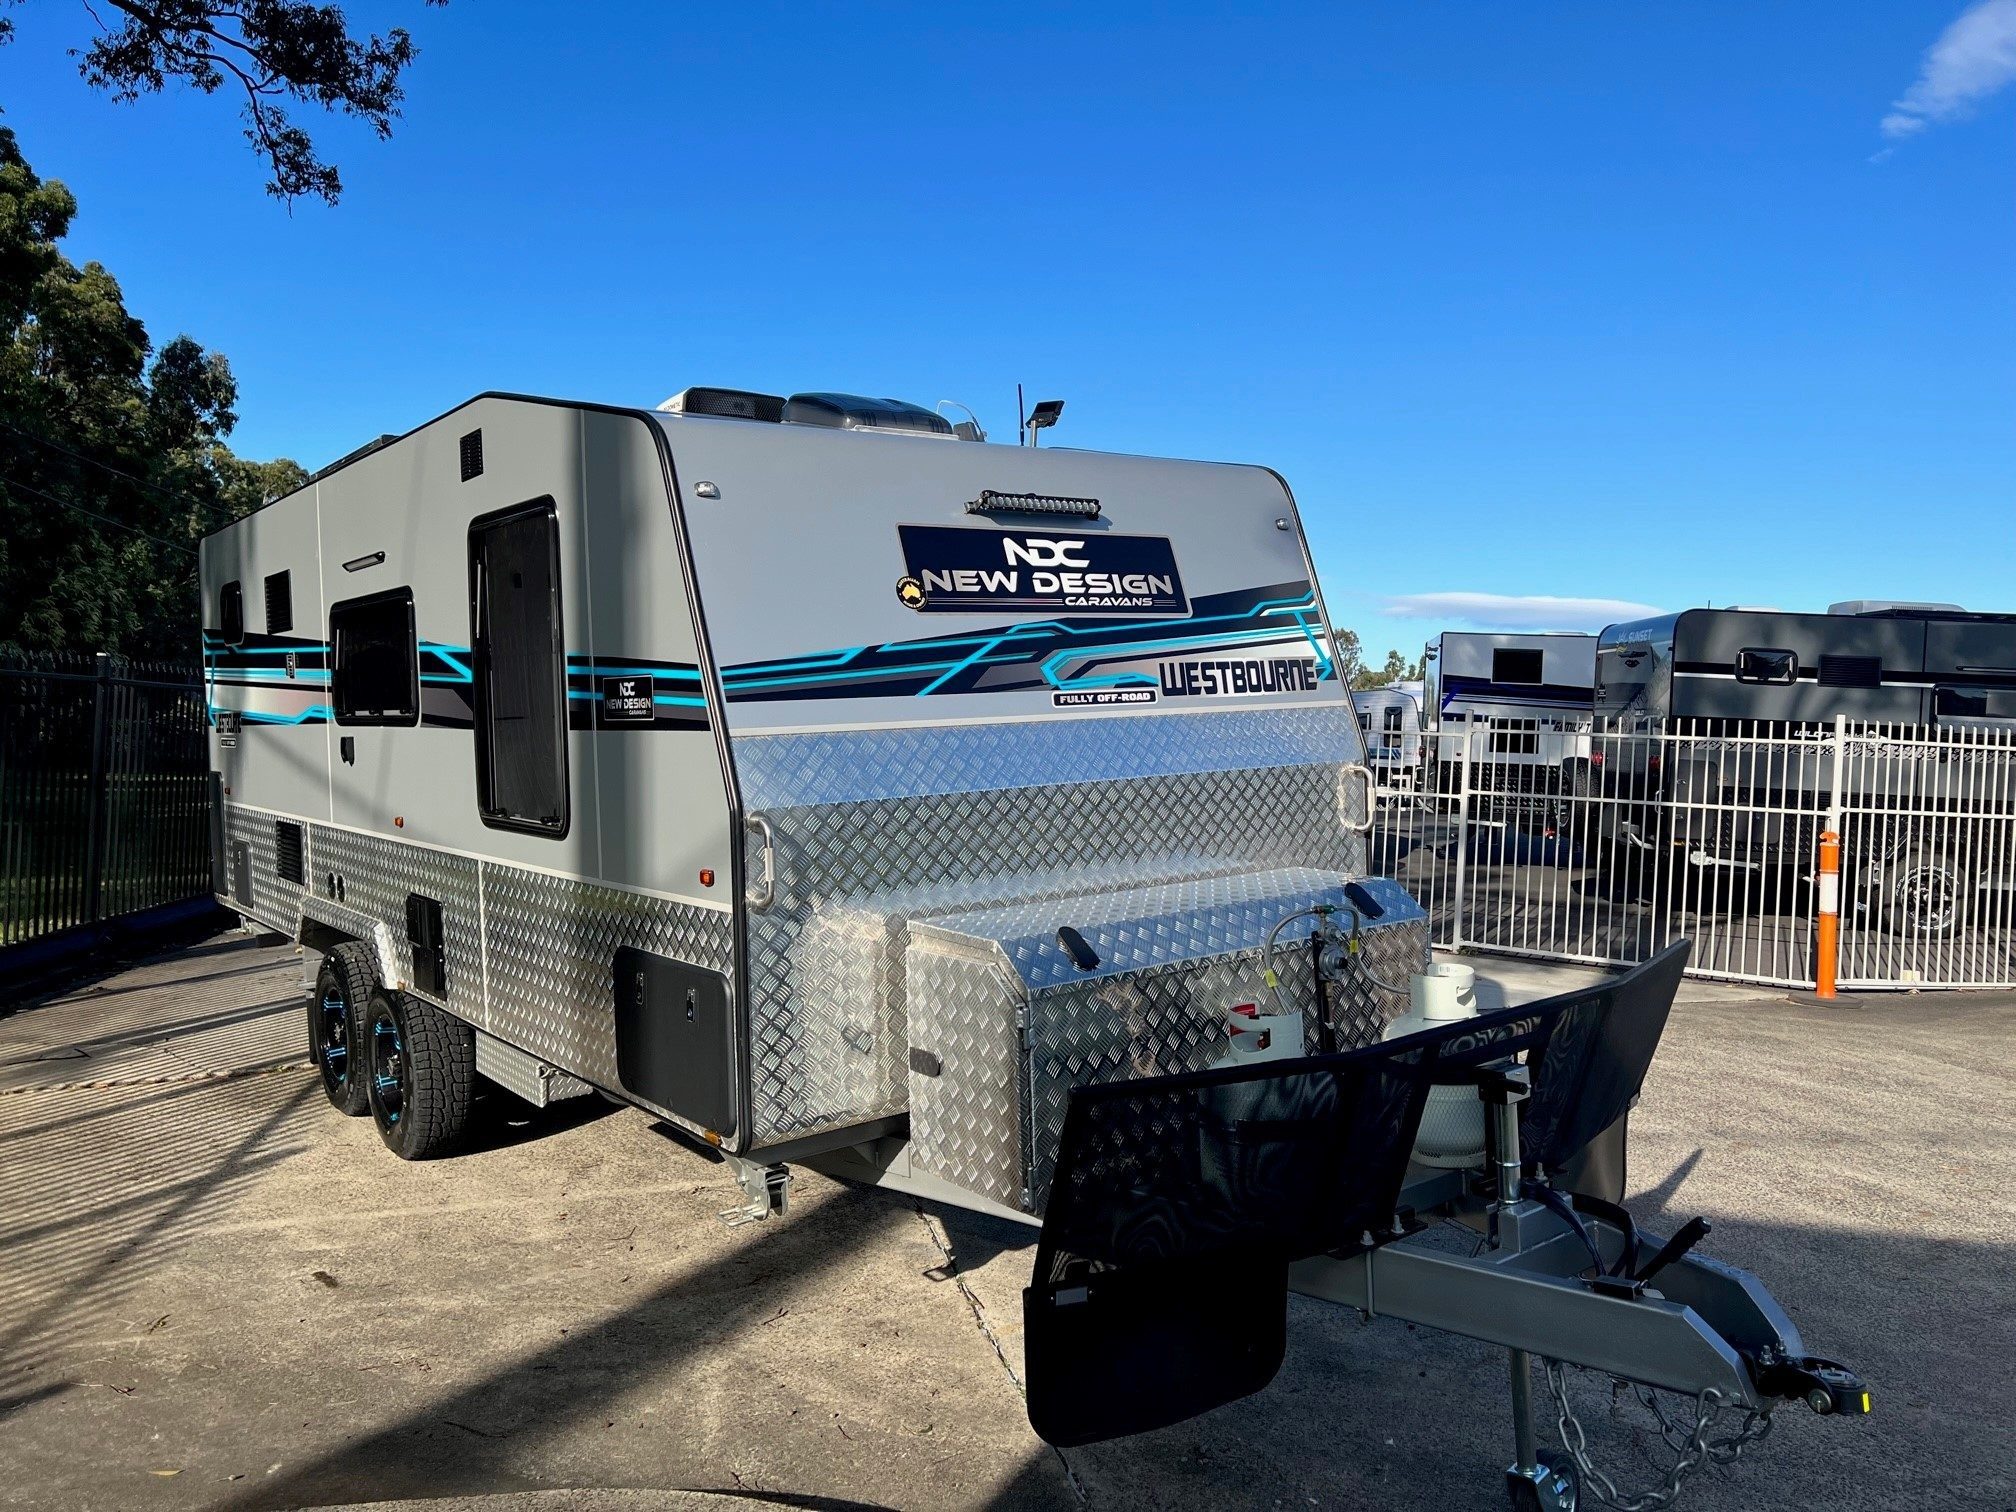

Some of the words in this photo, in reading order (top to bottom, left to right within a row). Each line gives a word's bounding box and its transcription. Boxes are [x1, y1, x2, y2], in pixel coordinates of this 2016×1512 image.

[1002, 537, 1091, 568] NDC
[921, 568, 1018, 593] NEW
[1032, 571, 1174, 595] DESIGN
[1064, 596, 1153, 607] CARAVANS
[1158, 658, 1318, 697] WESTBOURNE
[619, 681, 635, 696] NDC
[606, 698, 623, 709] NEW
[623, 697, 651, 709] DESIGN
[1059, 694, 1095, 705] FULLY
[1096, 691, 1151, 703] OFF-ROAD
